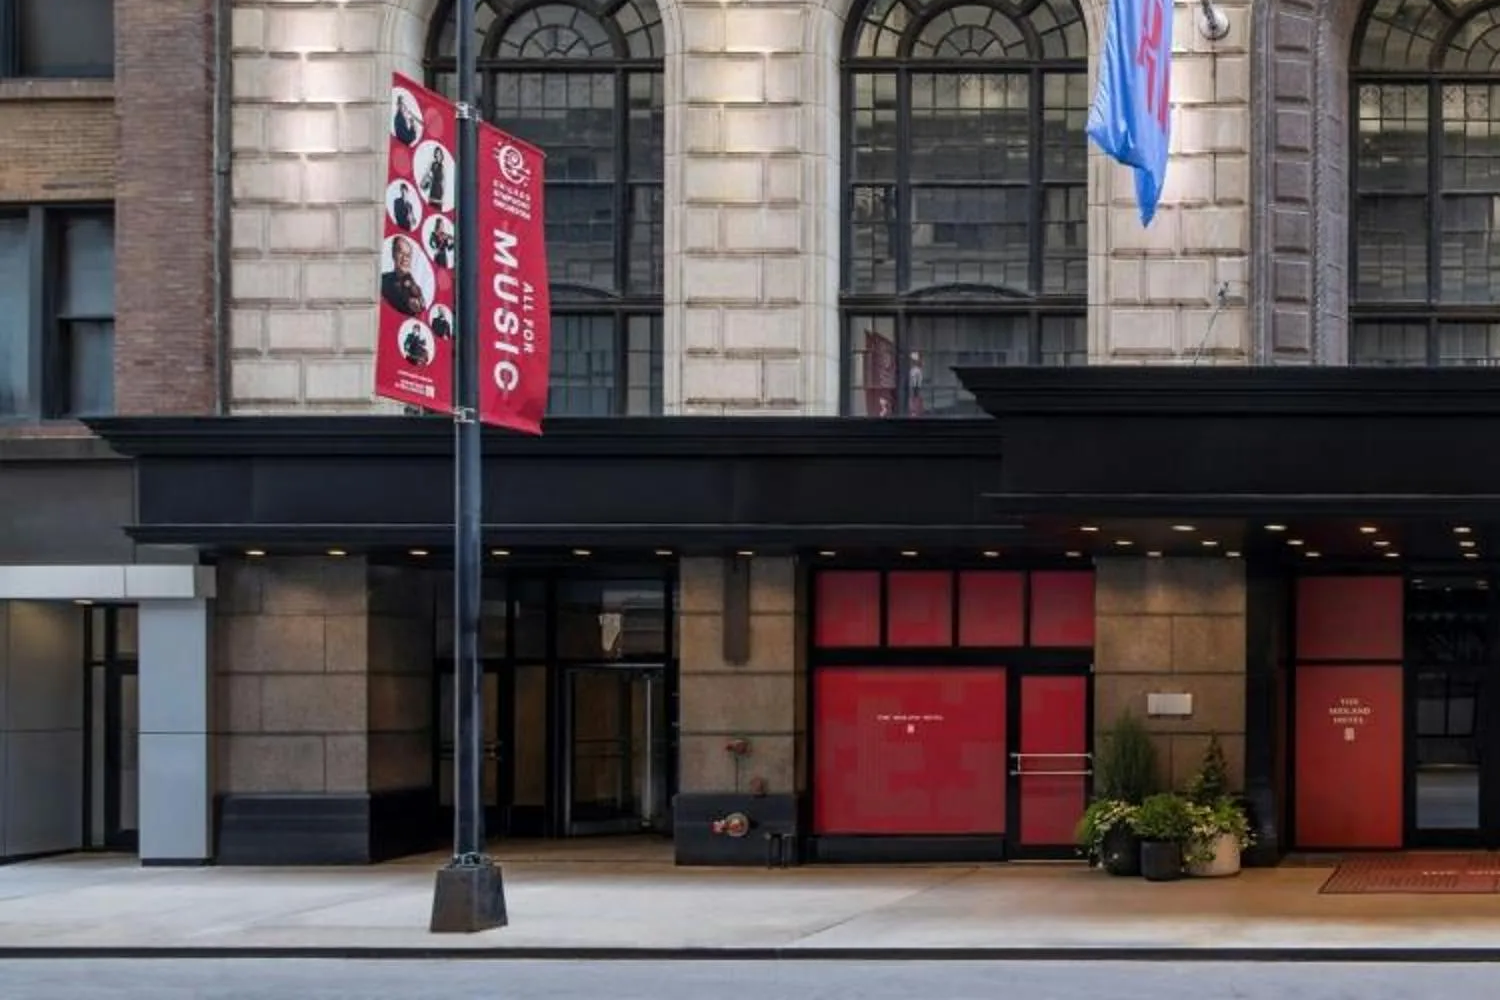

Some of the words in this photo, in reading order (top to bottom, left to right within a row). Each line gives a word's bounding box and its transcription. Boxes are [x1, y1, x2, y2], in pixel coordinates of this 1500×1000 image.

[493, 228, 519, 391] MUSIC
[523, 281, 534, 310] ALL
[523, 318, 535, 353] FOR
